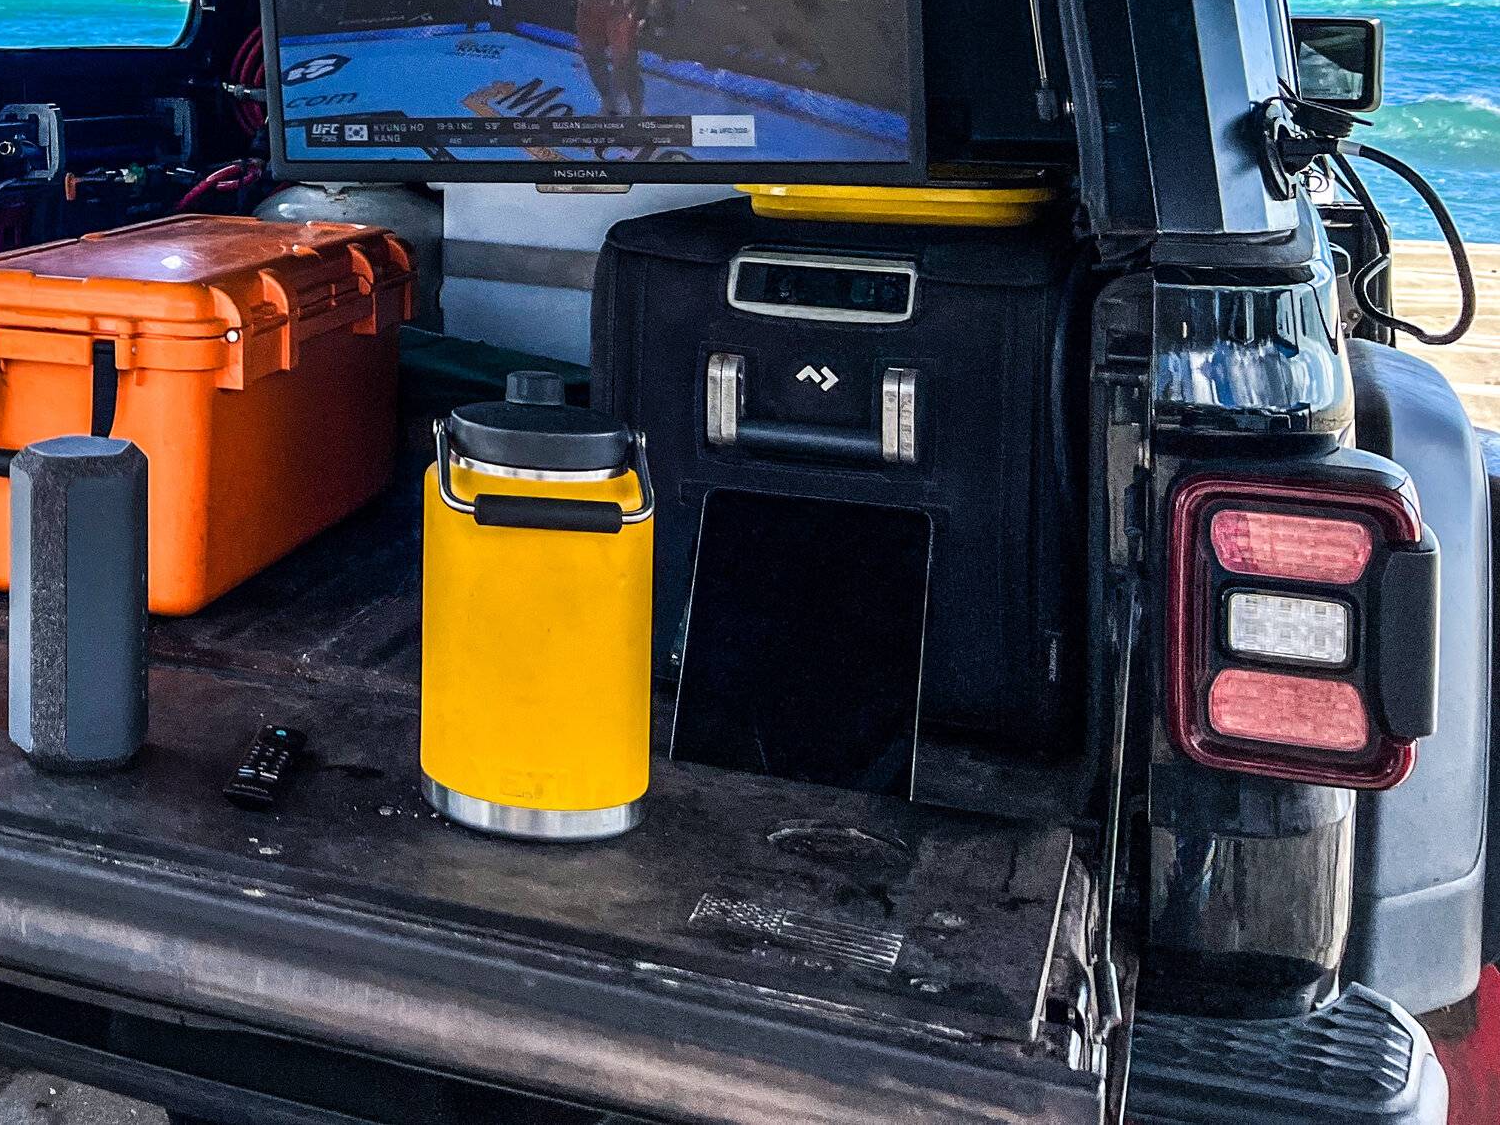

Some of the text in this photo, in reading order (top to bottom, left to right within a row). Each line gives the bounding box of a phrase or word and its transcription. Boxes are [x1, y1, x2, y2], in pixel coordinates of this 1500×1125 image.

[312, 123, 340, 135] UFC
[552, 121, 581, 129] BUSAN
[553, 169, 608, 178] INSIGNIA
